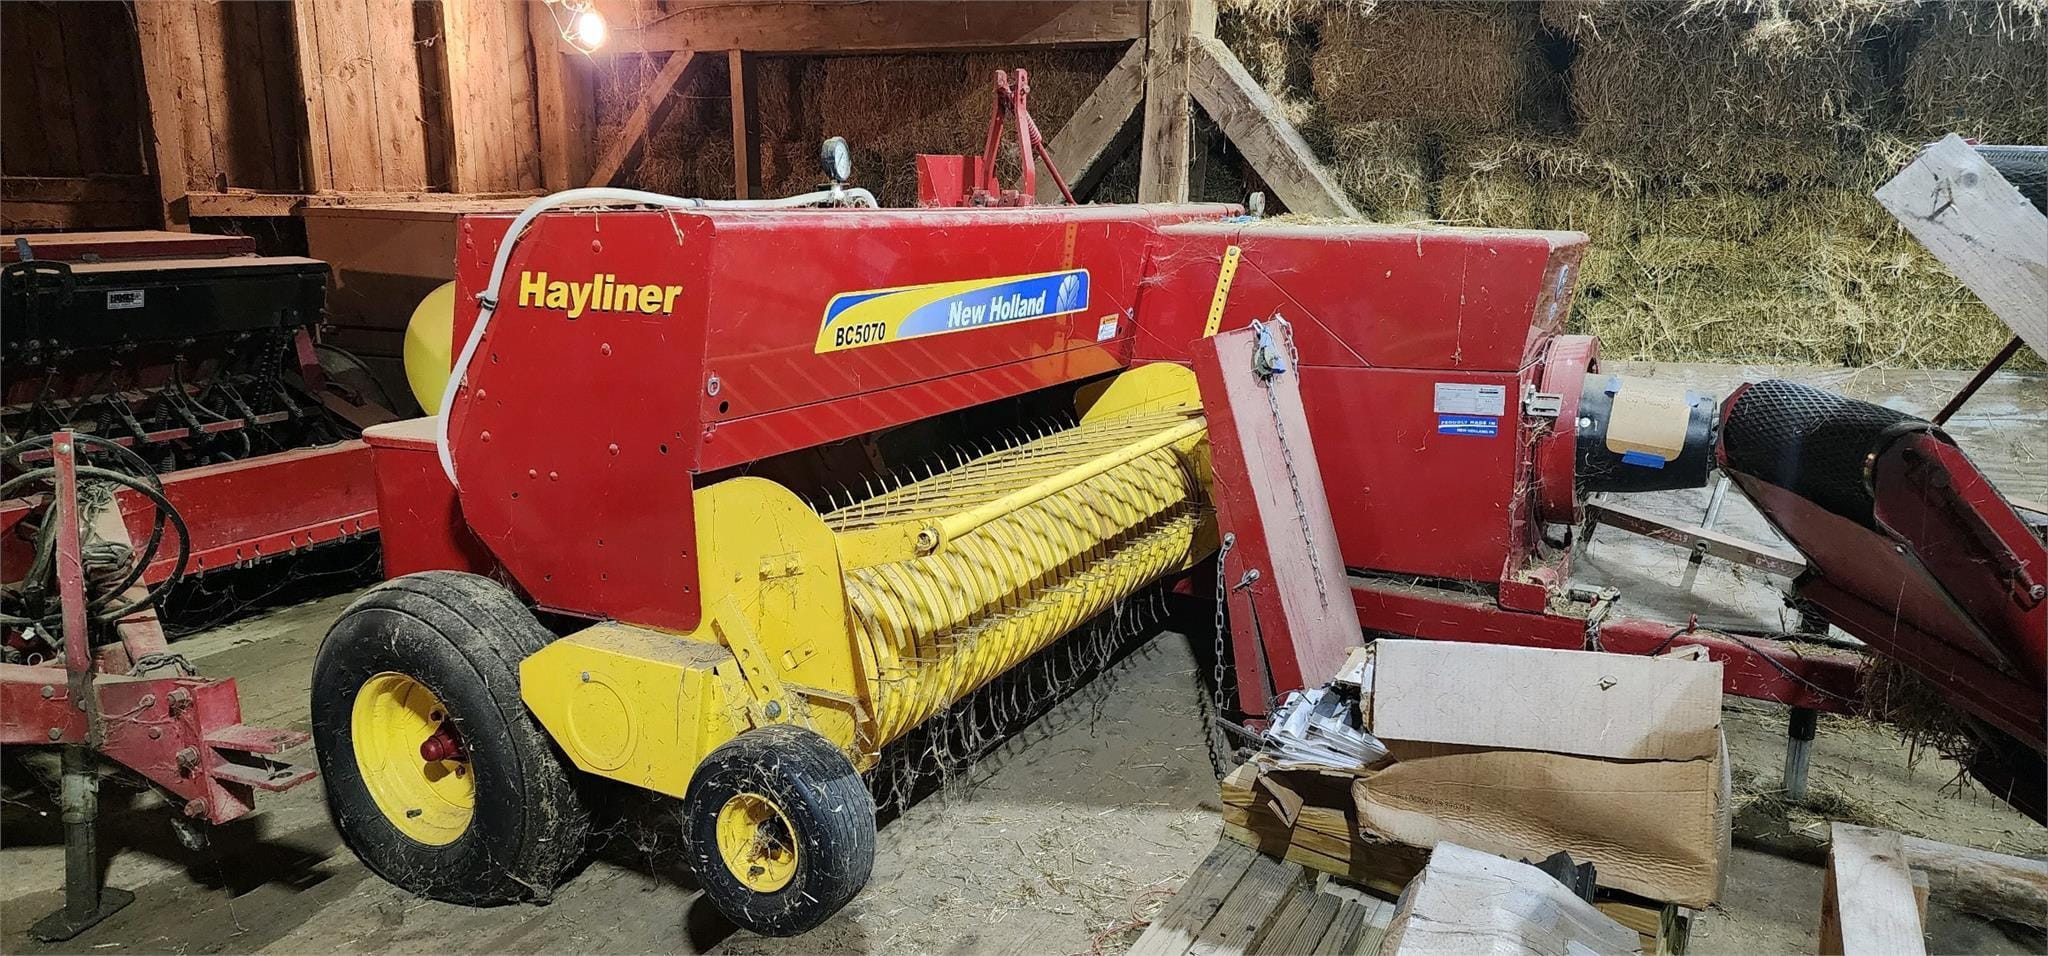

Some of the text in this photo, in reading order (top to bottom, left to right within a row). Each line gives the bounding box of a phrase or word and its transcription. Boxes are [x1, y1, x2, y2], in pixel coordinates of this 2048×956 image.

[518, 271, 683, 319] Hayliner
[947, 290, 1047, 328] New Holland
[835, 321, 886, 347] BC5070
